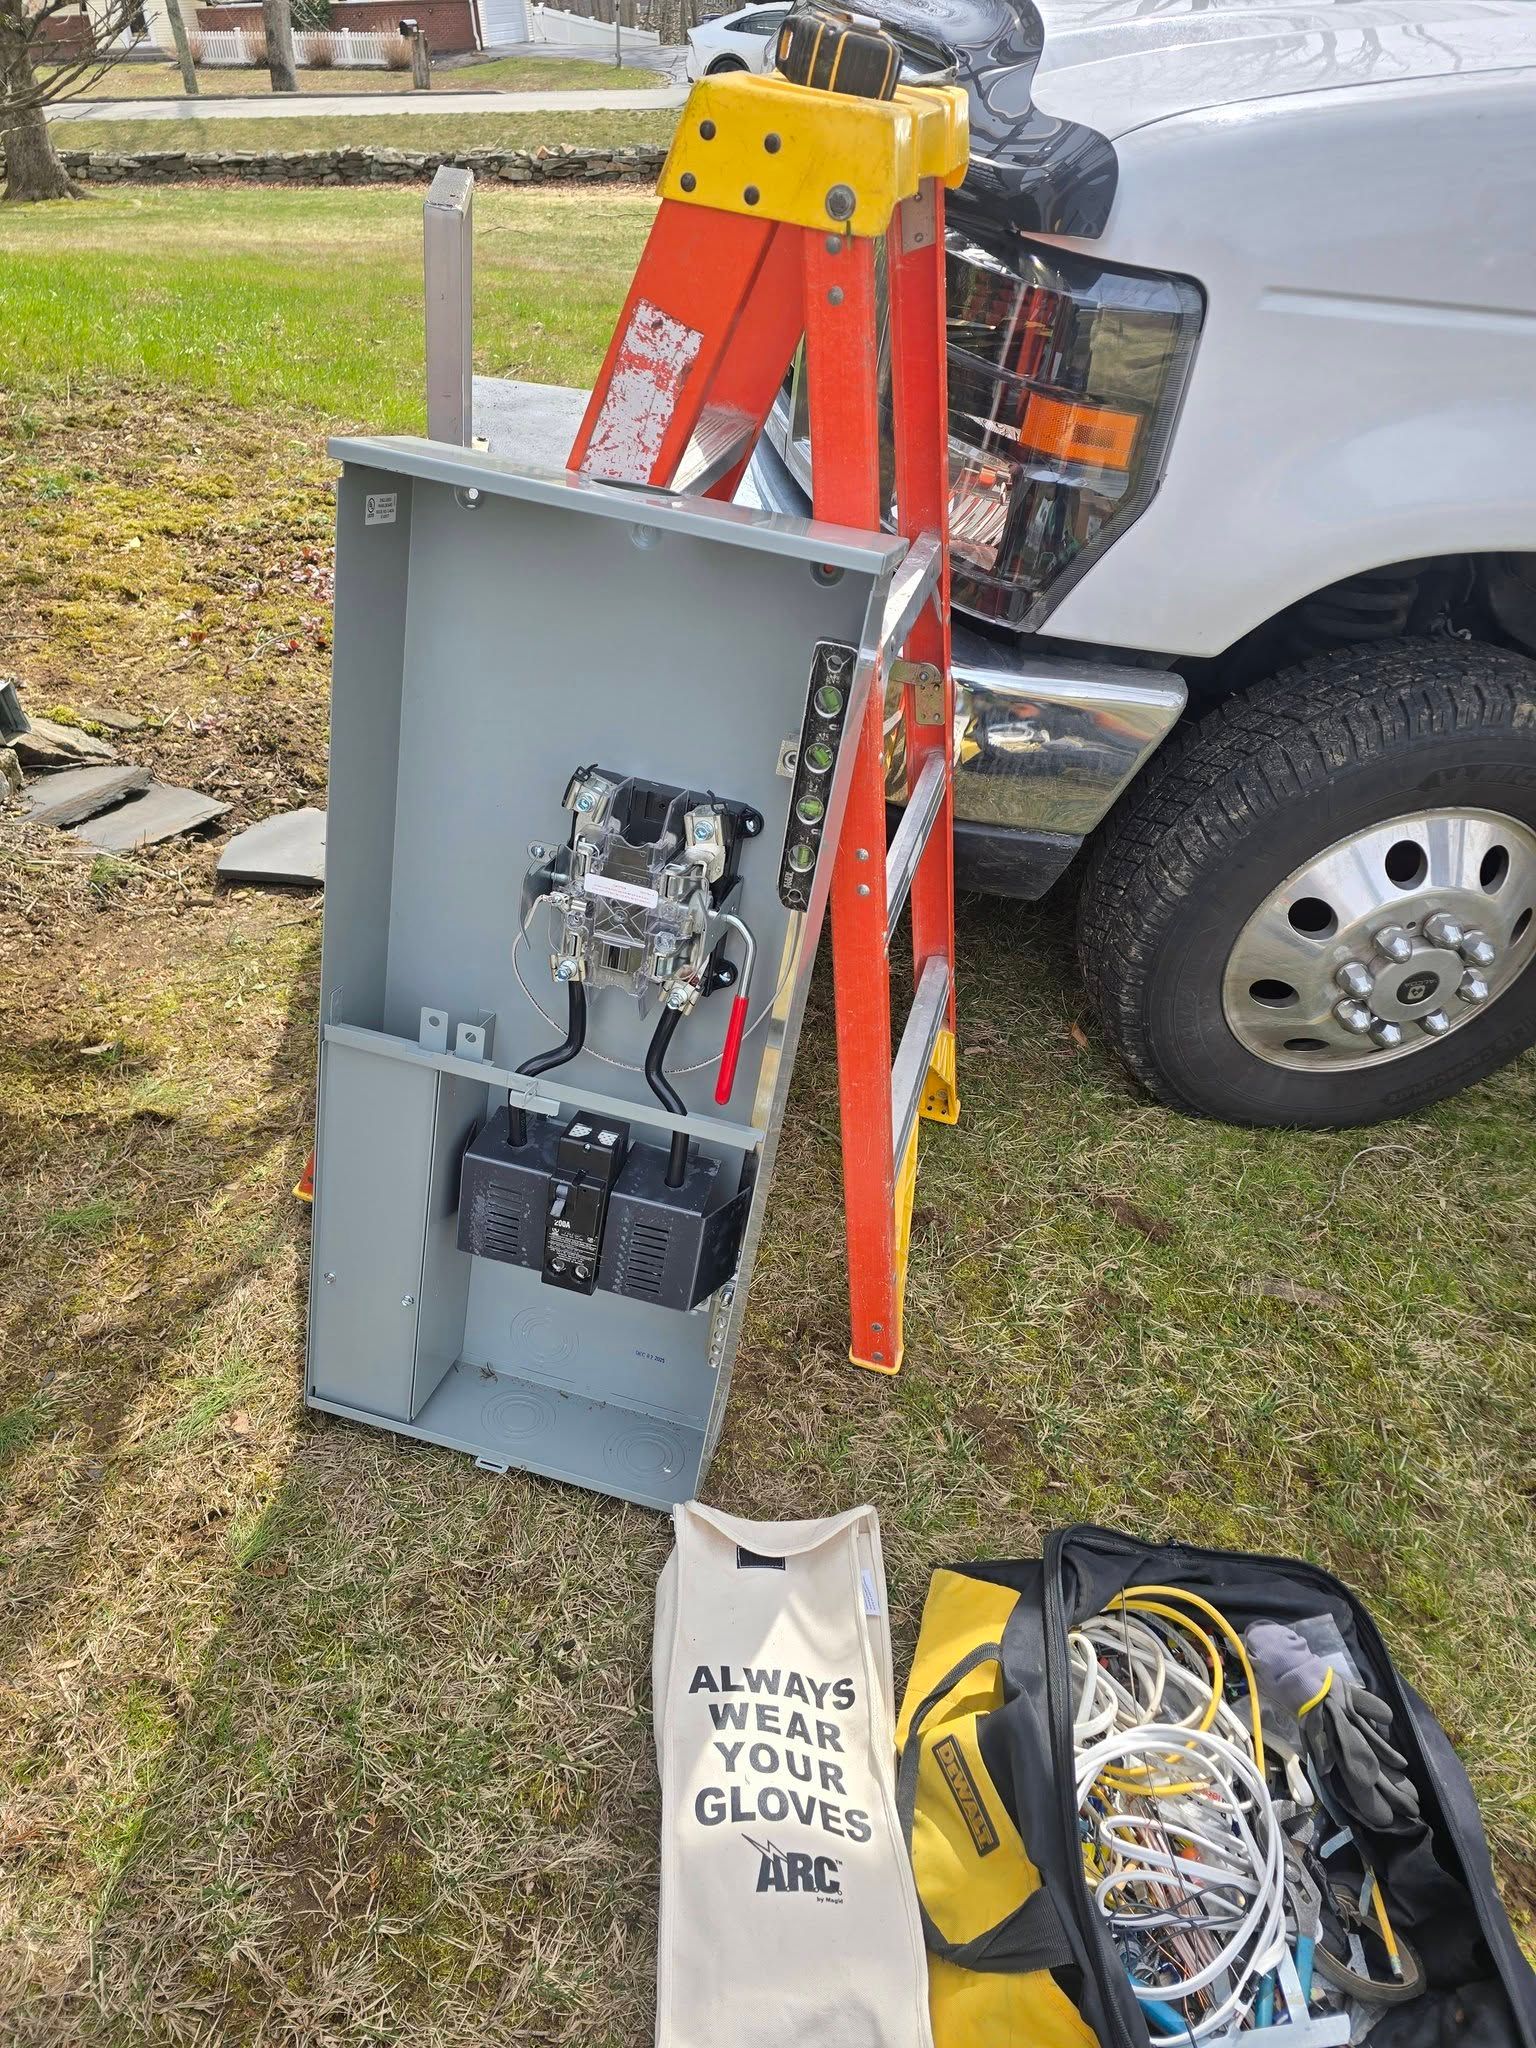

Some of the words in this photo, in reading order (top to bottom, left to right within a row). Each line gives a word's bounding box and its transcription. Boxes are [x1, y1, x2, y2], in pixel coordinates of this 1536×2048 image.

[553, 1219, 571, 1229] 200A
[688, 1665, 856, 1711] ALWAYS
[708, 1702, 845, 1753] WEAR
[713, 1741, 847, 1796] YOUR
[694, 1786, 872, 1843] GLOVES
